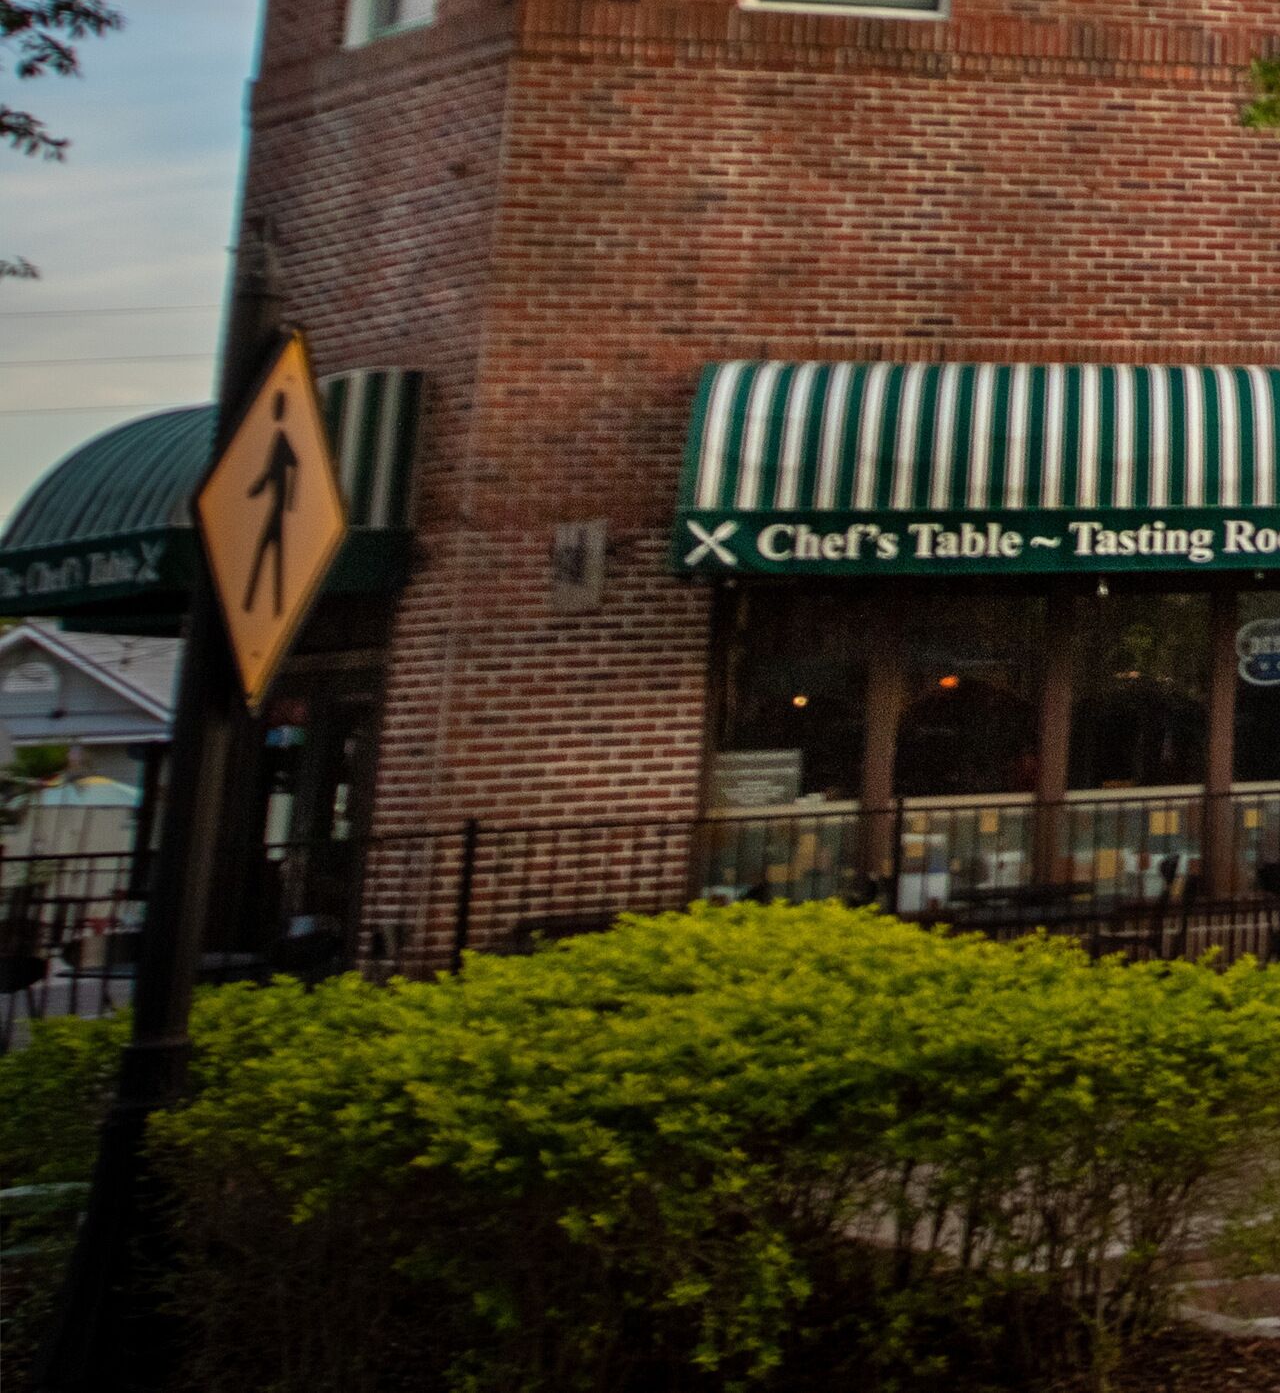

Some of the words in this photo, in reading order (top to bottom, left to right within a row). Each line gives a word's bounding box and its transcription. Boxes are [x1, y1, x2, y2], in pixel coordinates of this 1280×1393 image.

[756, 522, 900, 561] Chef's
[908, 522, 1024, 558] Table
[1068, 520, 1215, 563] Tasting
